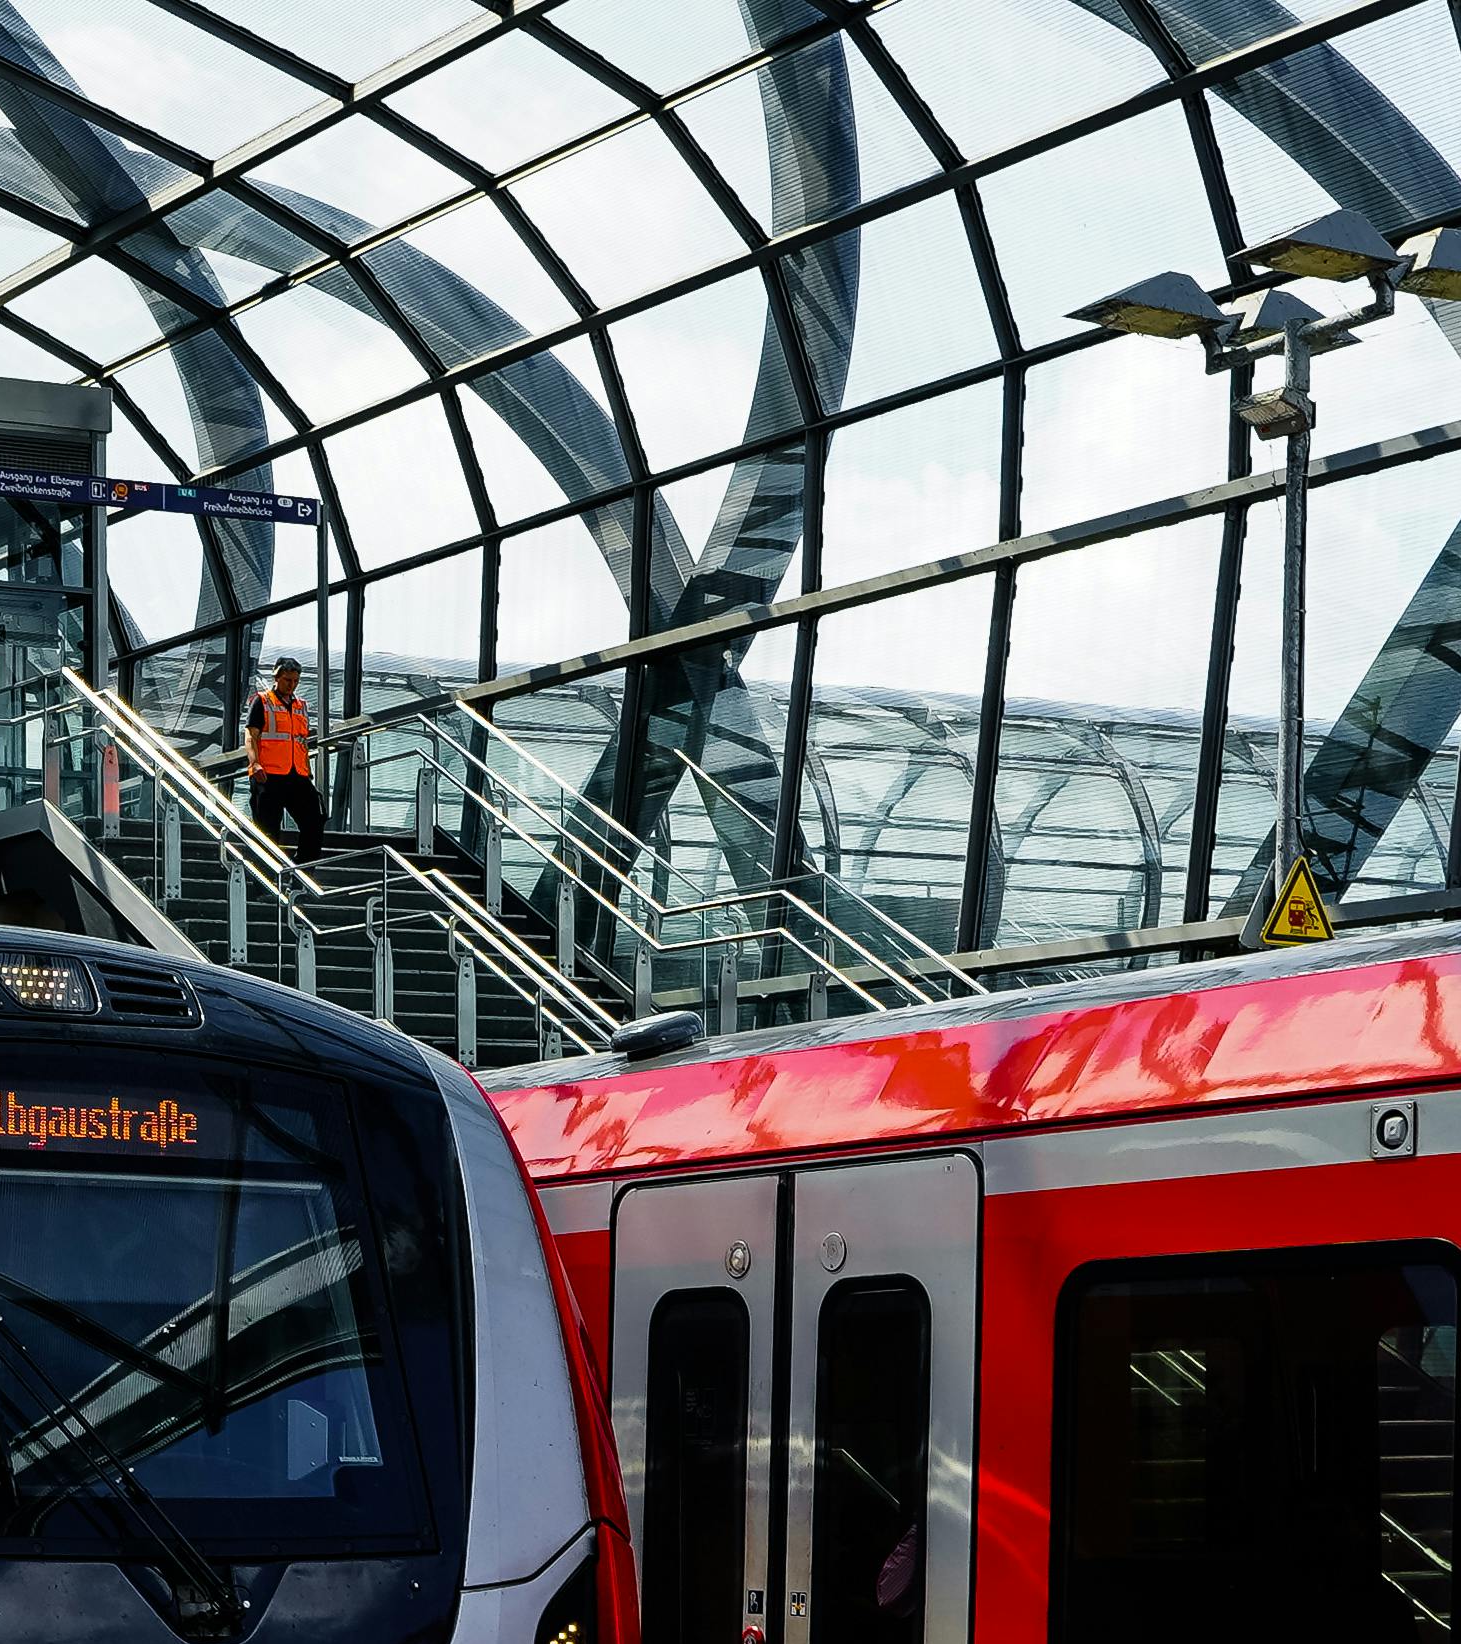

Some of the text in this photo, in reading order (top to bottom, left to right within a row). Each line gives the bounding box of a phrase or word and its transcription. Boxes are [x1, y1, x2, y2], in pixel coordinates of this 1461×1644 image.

[0, 471, 33, 484] Ausgang
[50, 475, 84, 487] Elbtower
[0, 482, 72, 498] Zweibrückenstraße
[228, 493, 260, 506] Ausgang
